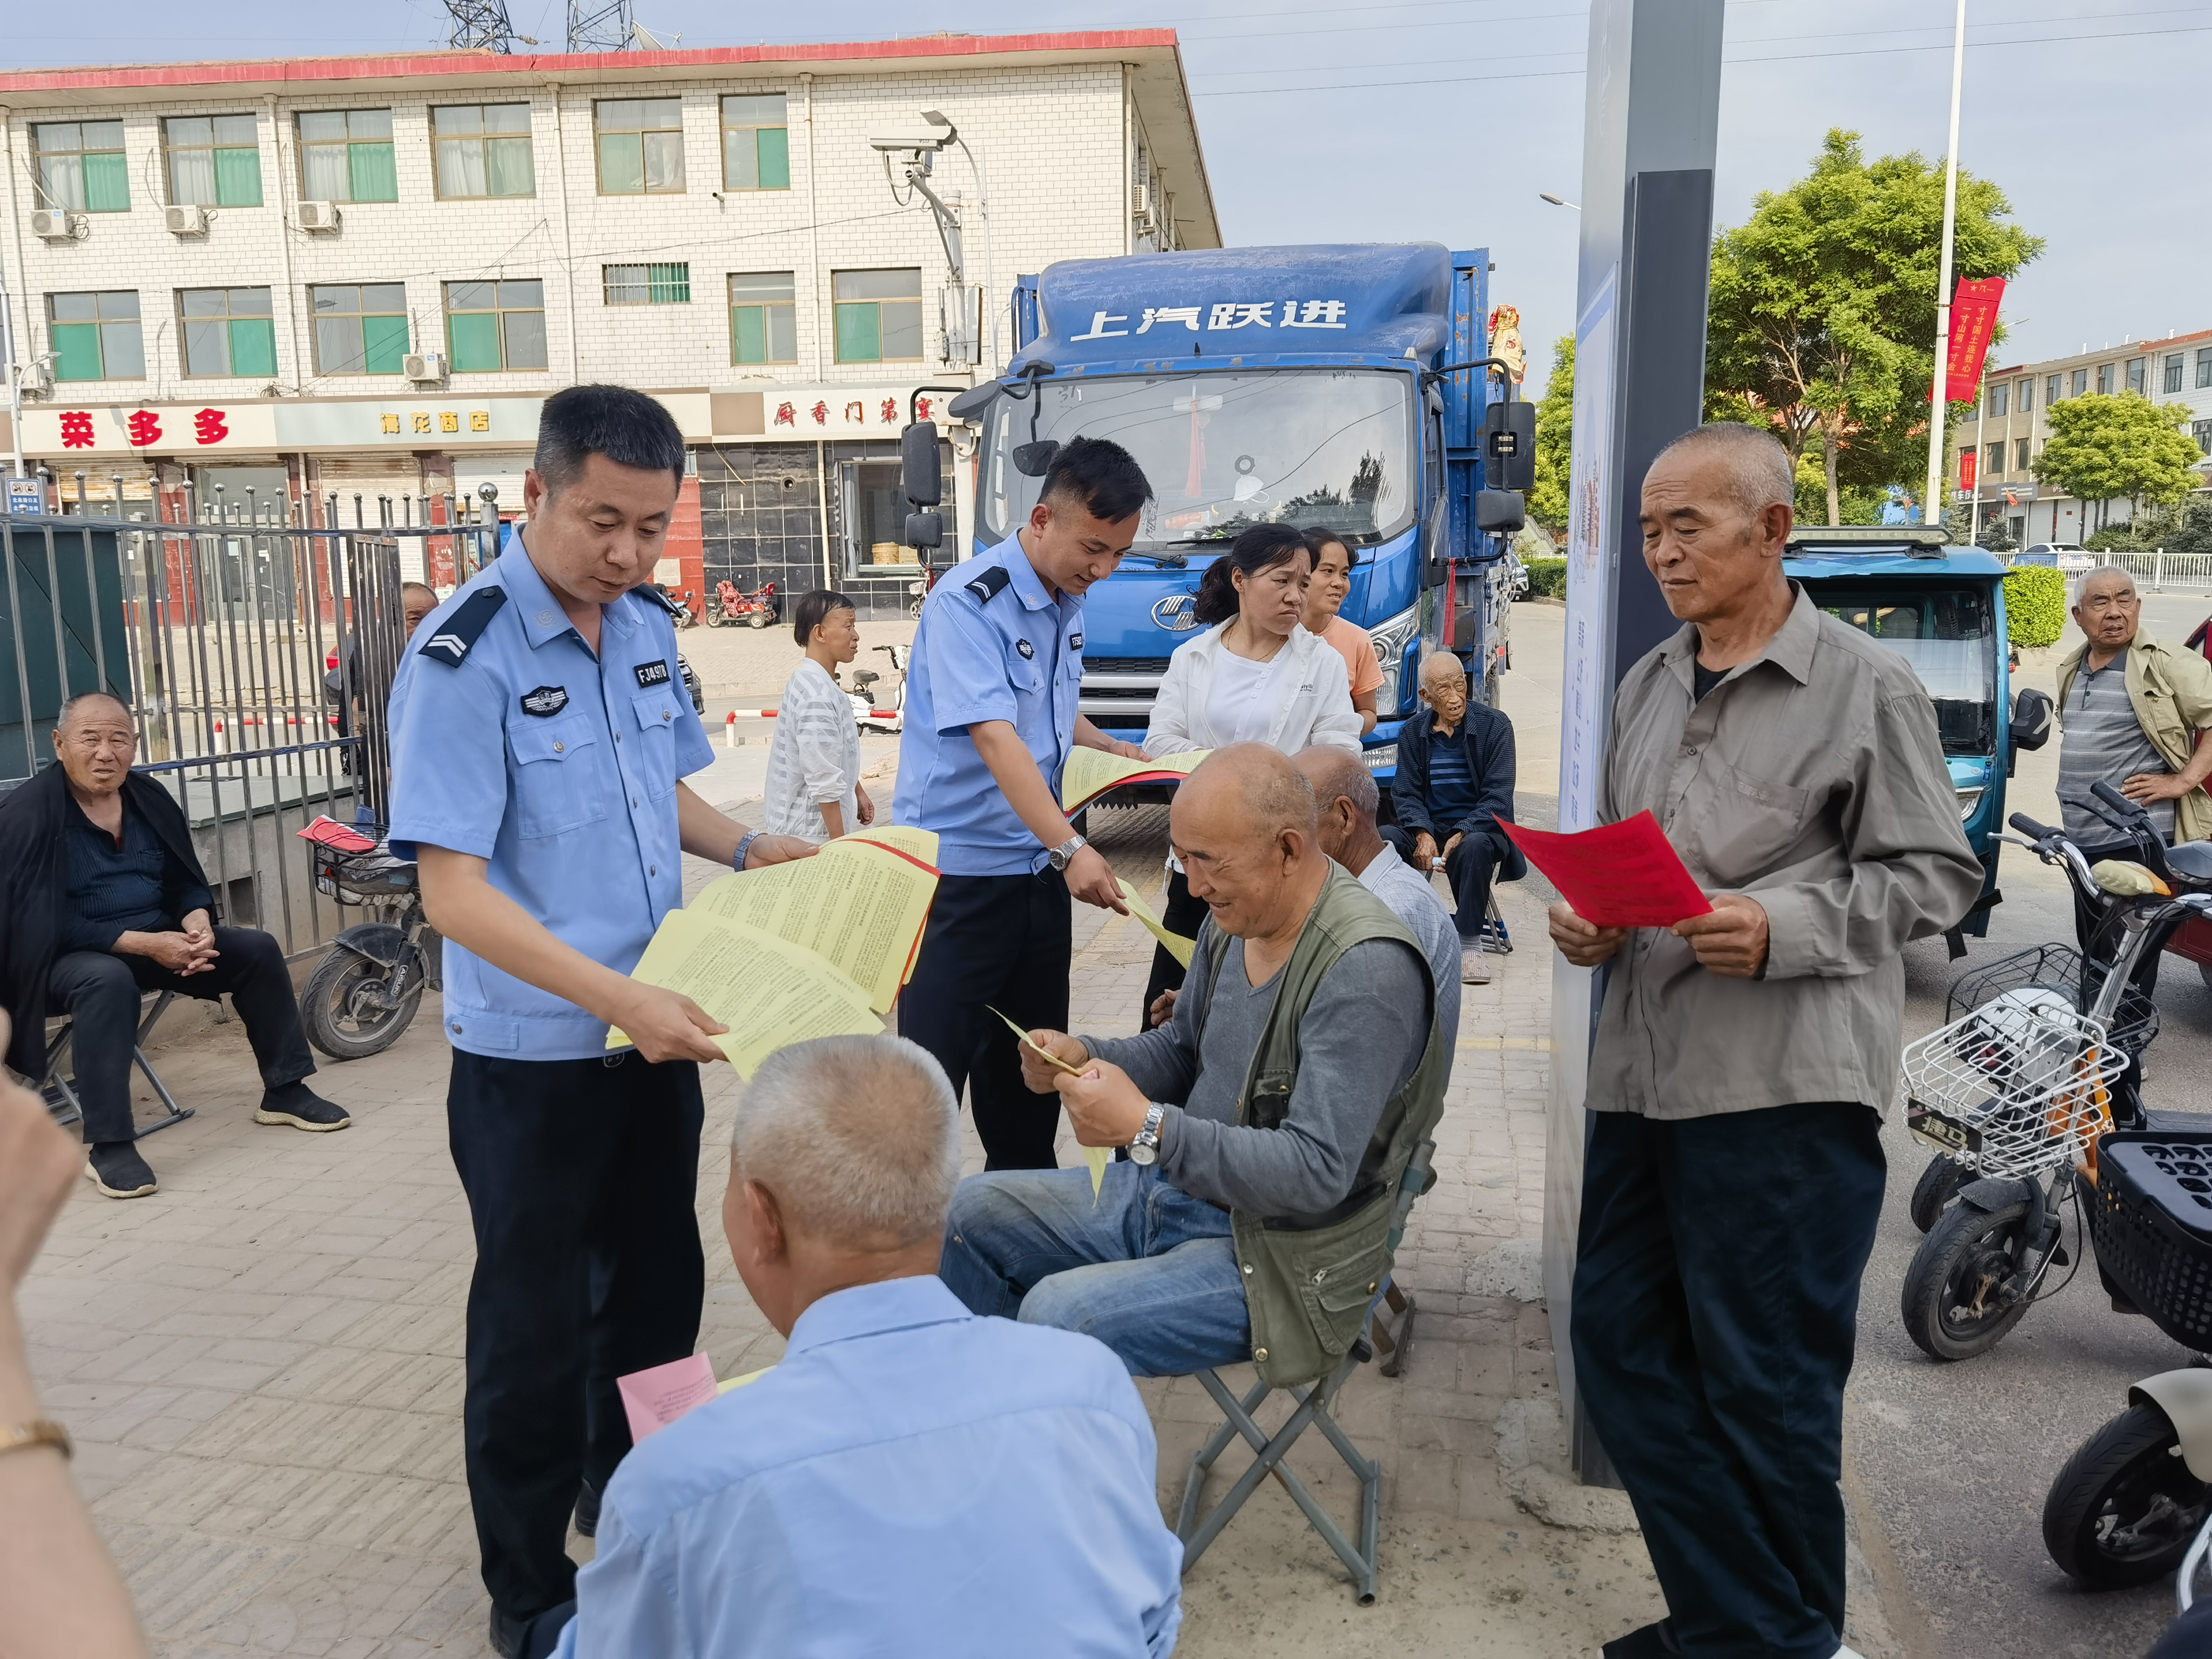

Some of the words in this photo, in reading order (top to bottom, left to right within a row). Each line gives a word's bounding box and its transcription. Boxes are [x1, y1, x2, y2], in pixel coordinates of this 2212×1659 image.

[1070, 300, 1346, 341] 上汽跃进
[1947, 307, 1972, 371] 一寸山河一寸金
[1961, 306, 1987, 373] 寸寸国土连我心
[59, 408, 228, 448] 菜多多
[638, 664, 667, 683] FJ4978
[394, 967, 406, 994] AISUN
